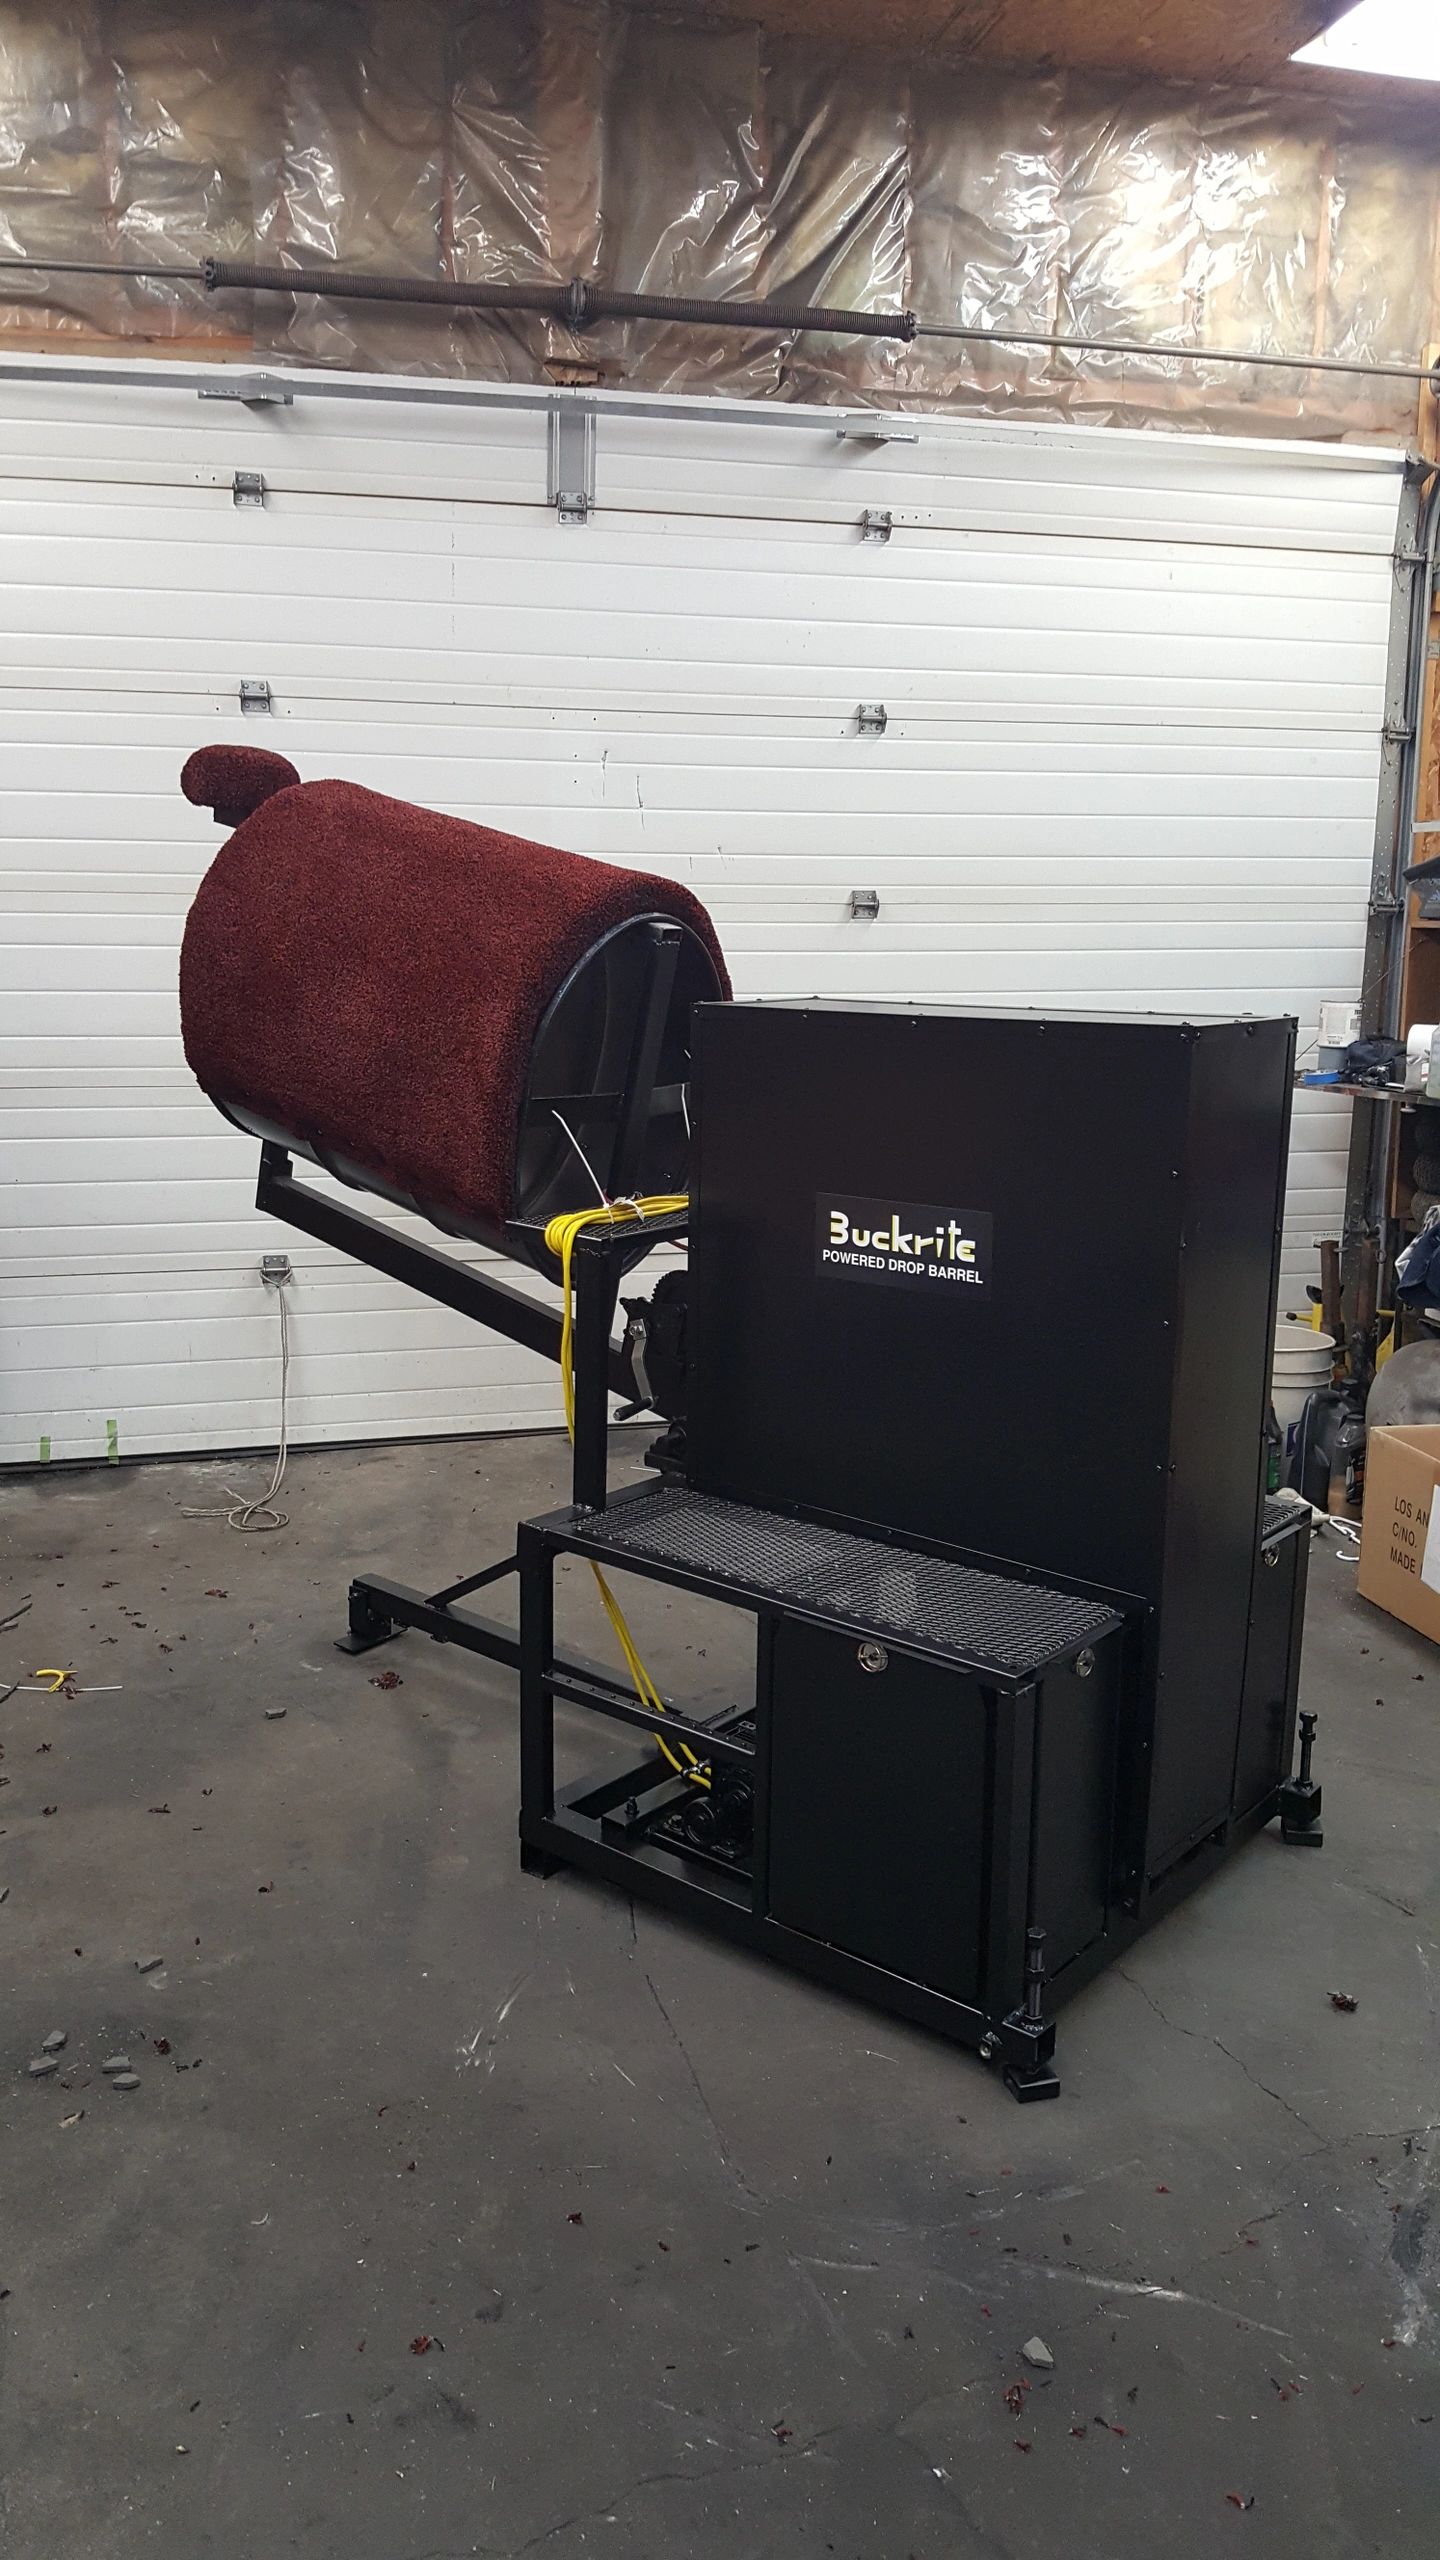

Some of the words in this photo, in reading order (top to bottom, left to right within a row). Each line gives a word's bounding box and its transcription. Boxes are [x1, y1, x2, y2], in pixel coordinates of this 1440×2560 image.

[830, 1210, 976, 1263] Buckrite
[822, 1249, 886, 1269] POWERED
[888, 1258, 925, 1275] DROP
[928, 1264, 984, 1284] BARREL
[1394, 1496, 1412, 1518] LOS
[1390, 1546, 1416, 1574] MADE
